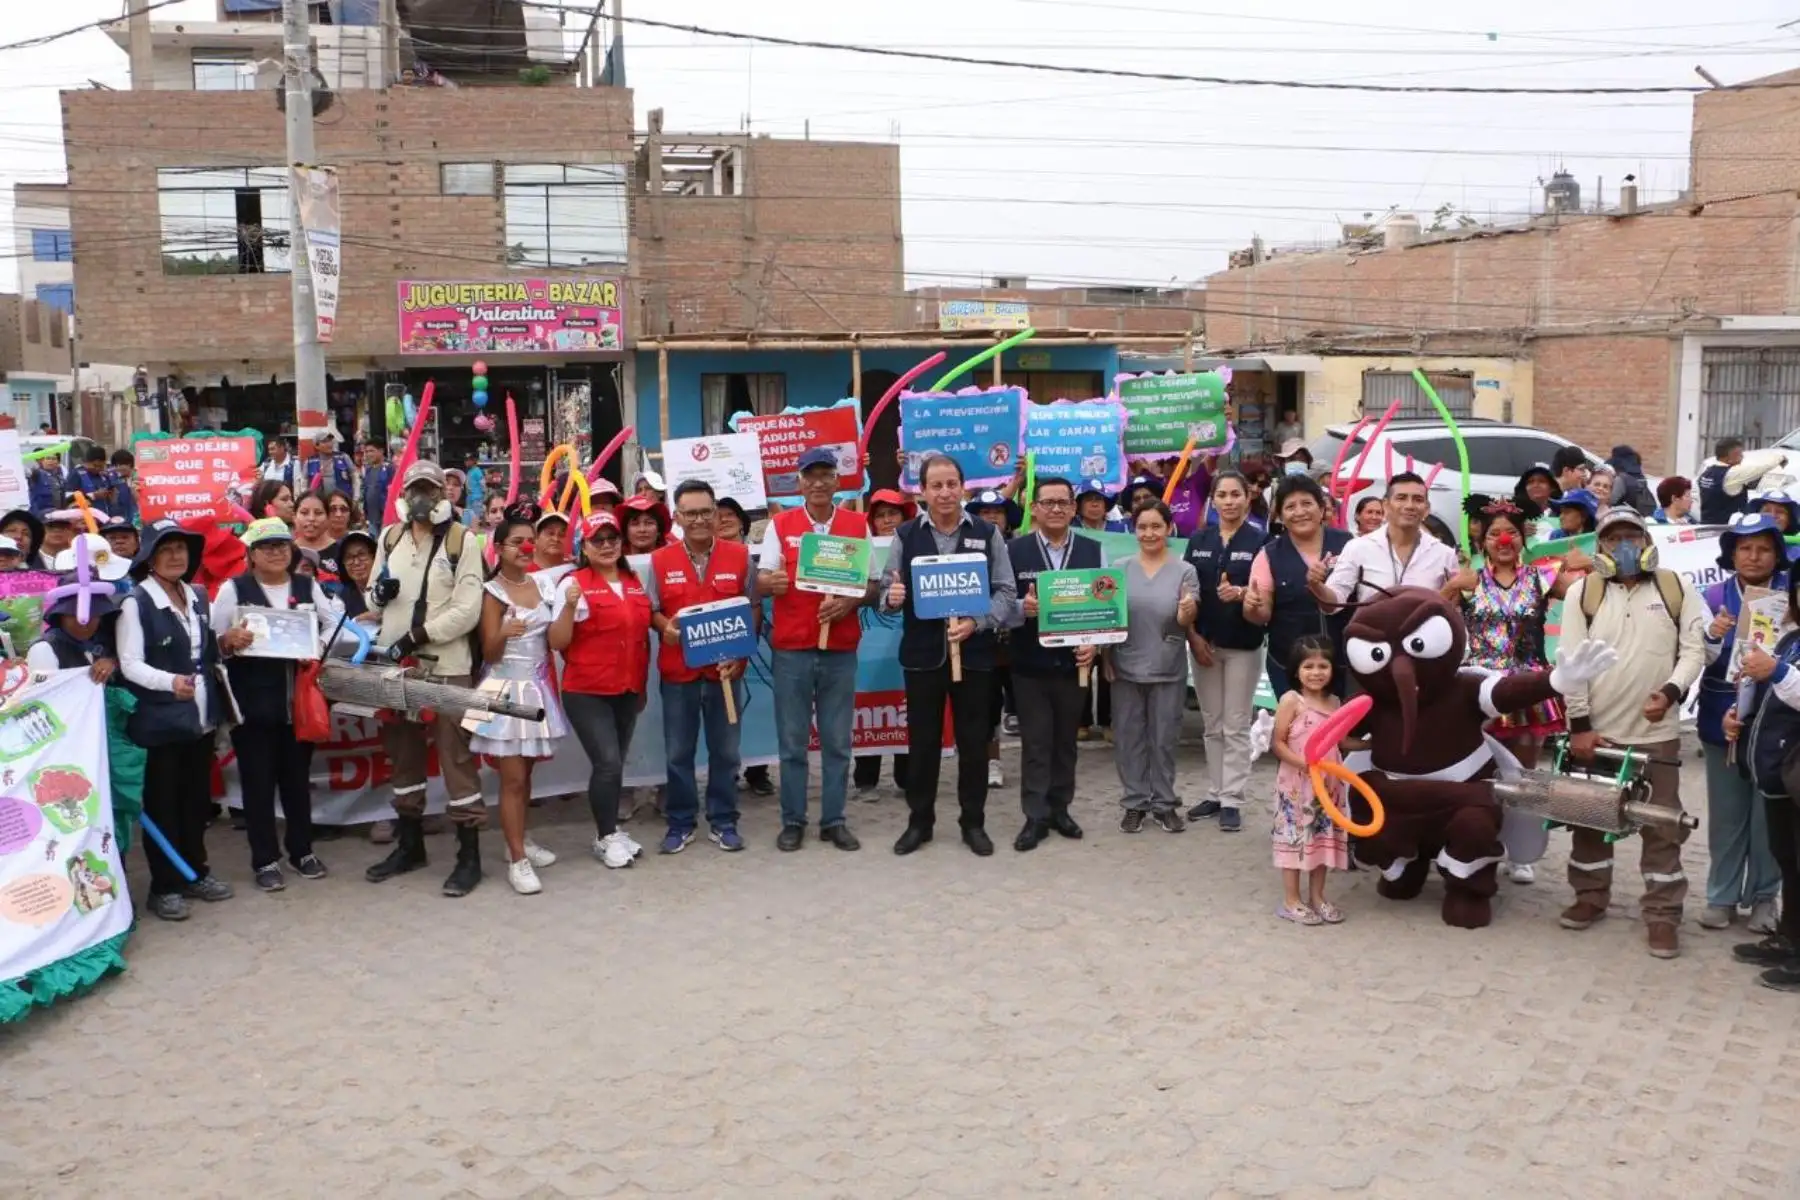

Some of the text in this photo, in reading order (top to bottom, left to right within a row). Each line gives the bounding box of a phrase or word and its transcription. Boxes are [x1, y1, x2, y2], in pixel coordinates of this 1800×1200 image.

[404, 282, 529, 310] JUGUETERIA
[549, 282, 621, 308] BAZAR
[914, 409, 931, 418] LA
[763, 430, 817, 443] ADURAS
[914, 424, 990, 439] EMPIEZA EN
[1029, 423, 1117, 437] LAS GANAS DE
[170, 441, 239, 453] NO DEJES
[762, 443, 807, 456] ANDES
[943, 443, 977, 453] CASA
[175, 458, 230, 470] QUE EL
[1034, 463, 1072, 474] ENGUE
[145, 471, 240, 486] DENGUE SEA
[148, 492, 212, 505] TU PEOR
[164, 508, 216, 520] VECINO
[920, 571, 981, 589] MINSA
[686, 615, 747, 640] MINSA
[868, 730, 906, 743] Puente
